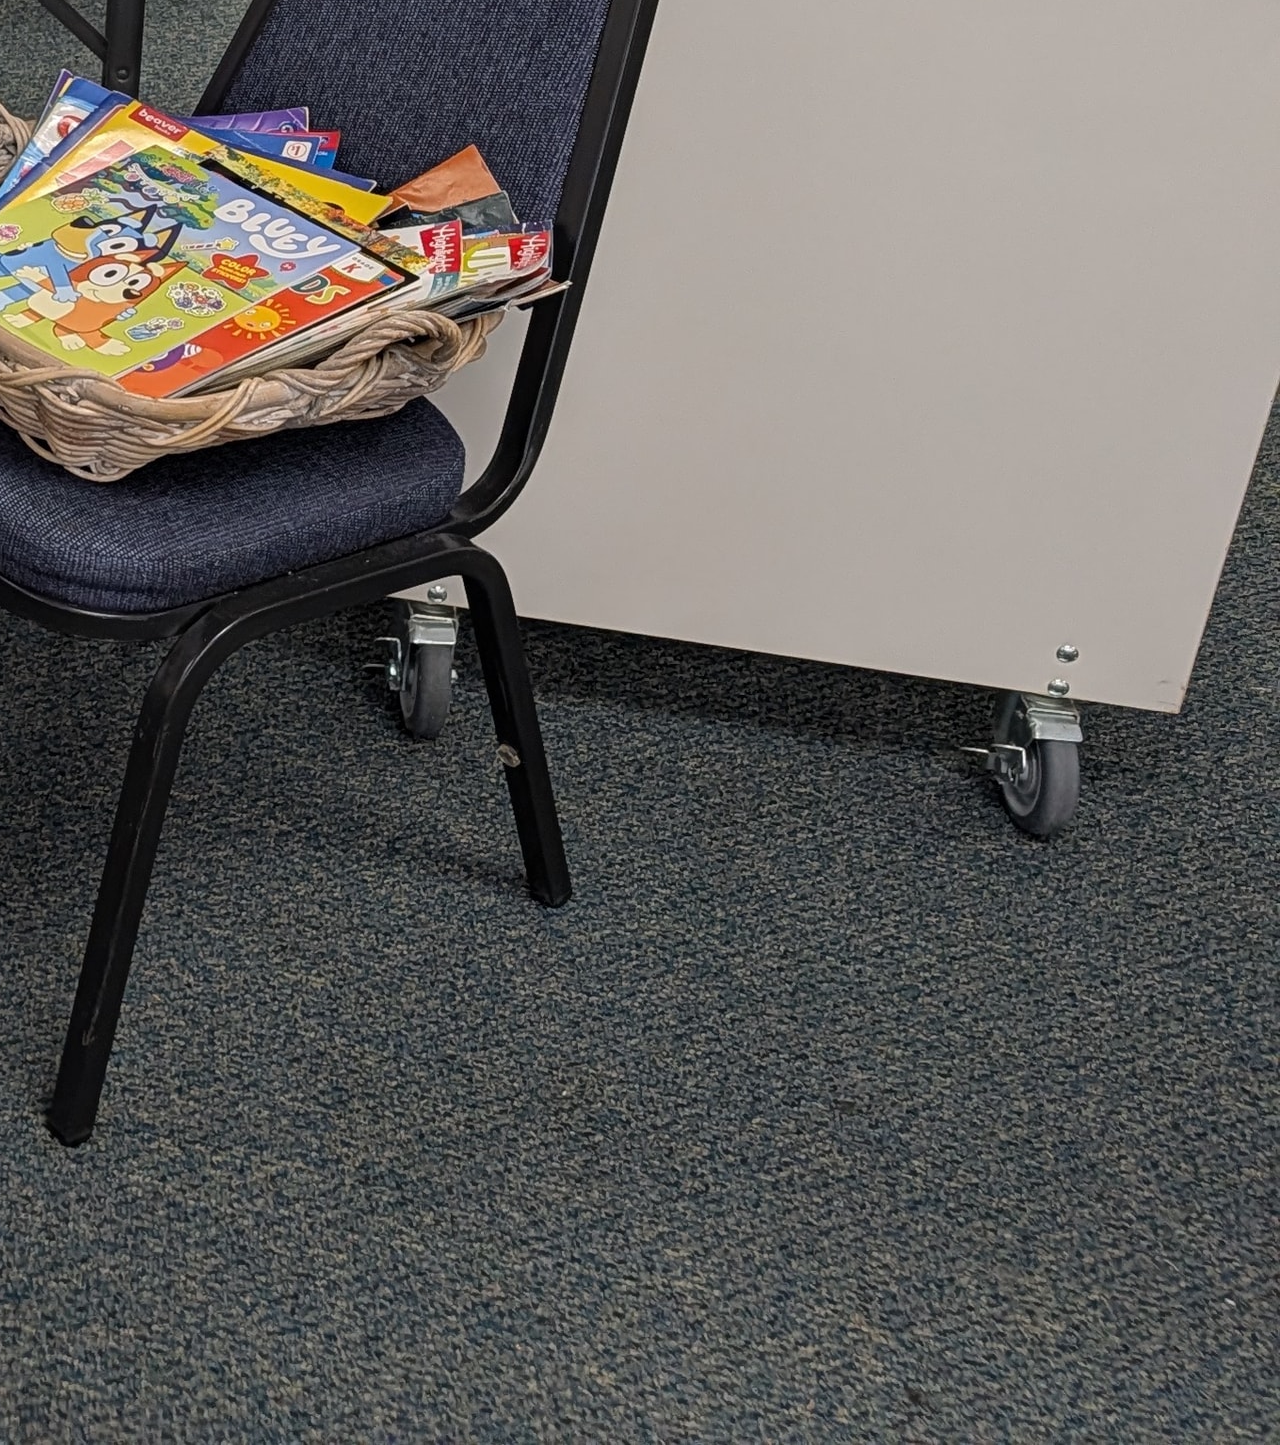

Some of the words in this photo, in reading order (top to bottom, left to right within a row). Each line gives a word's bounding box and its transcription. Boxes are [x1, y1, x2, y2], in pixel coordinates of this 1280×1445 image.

[138, 108, 182, 135] beaver
[214, 198, 341, 254] BLUEY
[220, 258, 257, 275] COLOR
[342, 263, 362, 273] K
